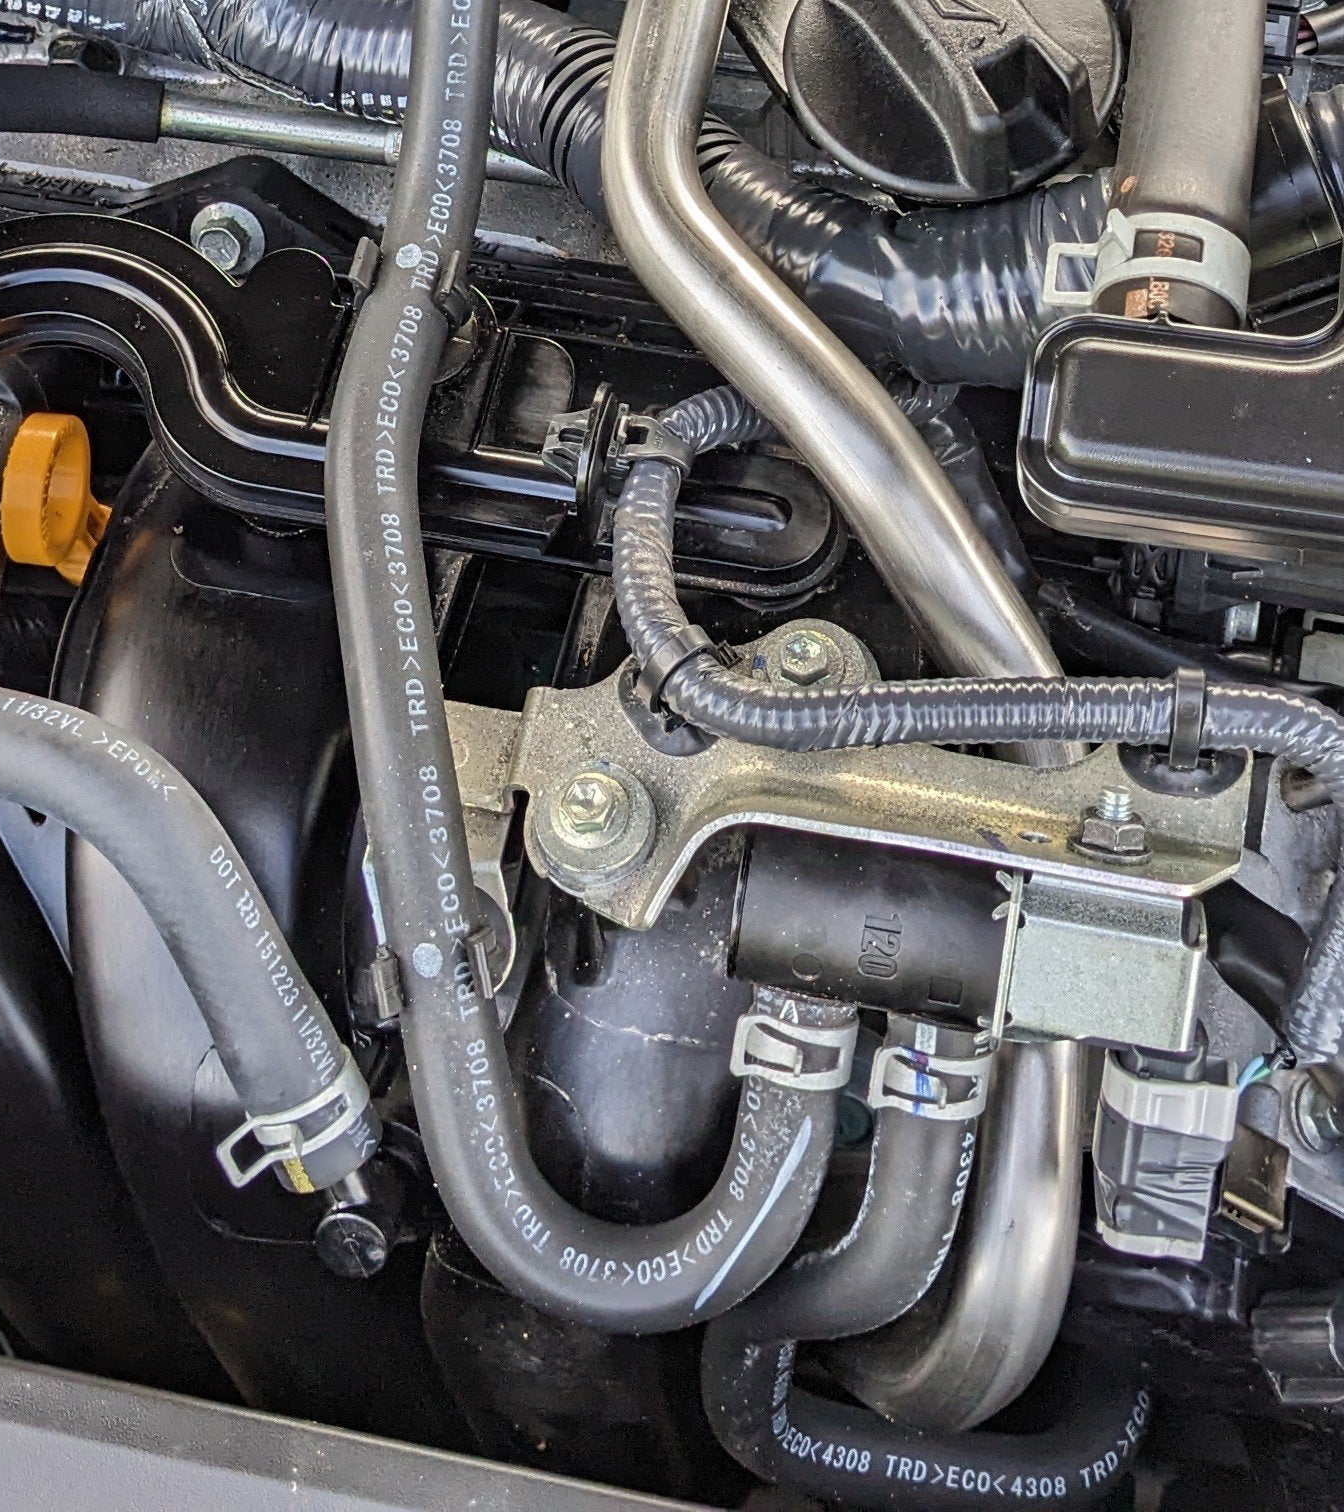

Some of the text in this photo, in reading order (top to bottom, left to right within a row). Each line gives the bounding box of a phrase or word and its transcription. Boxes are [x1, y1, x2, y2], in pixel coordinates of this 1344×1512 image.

[209, 844, 242, 889] DOT
[255, 931, 299, 1007] 151223
[858, 913, 902, 980] 120
